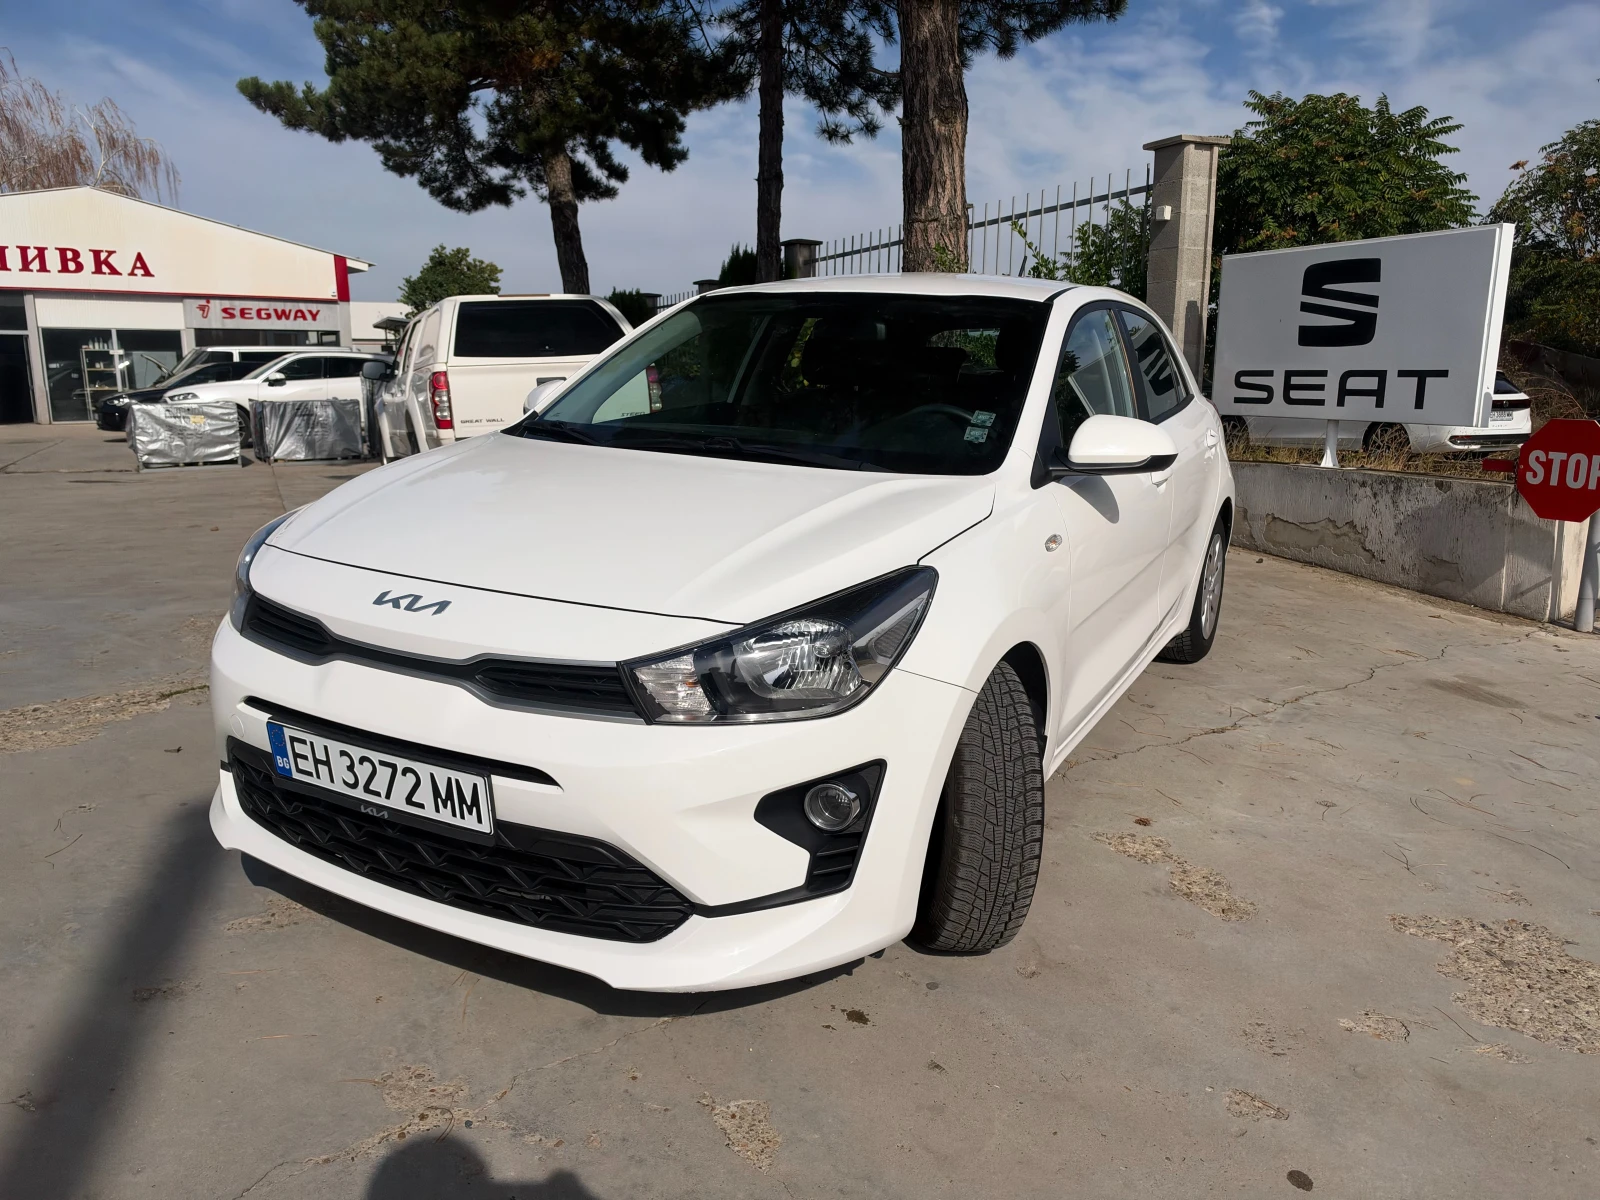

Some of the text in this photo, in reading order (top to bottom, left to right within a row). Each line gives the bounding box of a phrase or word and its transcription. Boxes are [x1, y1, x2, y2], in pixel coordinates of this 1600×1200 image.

[221, 307, 321, 322] SEGWAY
[1233, 369, 1449, 410] SEAT
[372, 589, 452, 616] KIA
[276, 755, 291, 770] BG
[288, 735, 483, 825] EH 3272 MM
